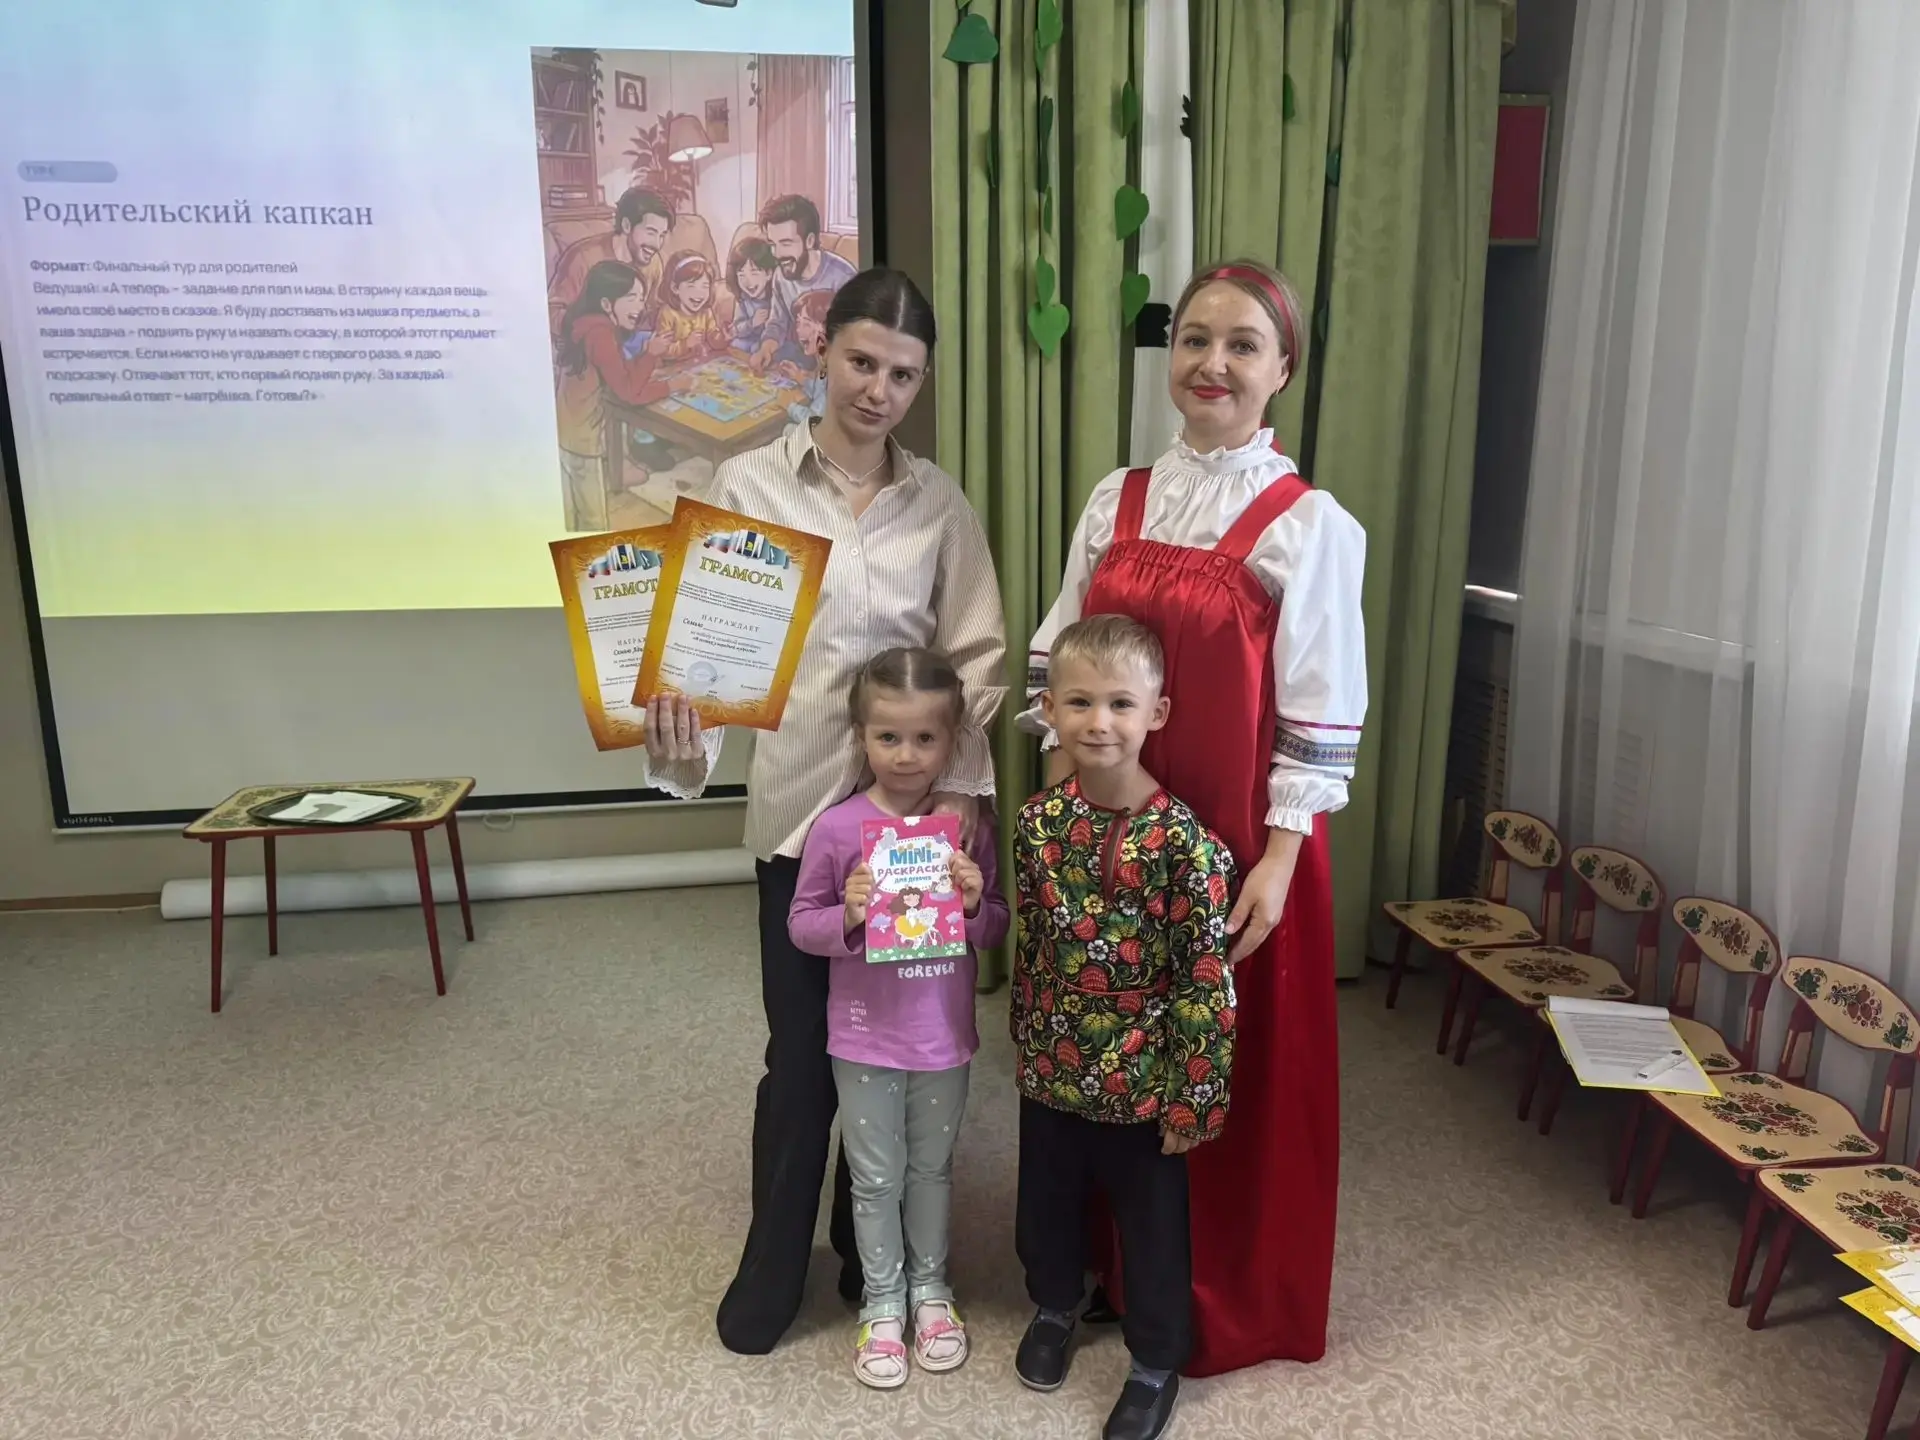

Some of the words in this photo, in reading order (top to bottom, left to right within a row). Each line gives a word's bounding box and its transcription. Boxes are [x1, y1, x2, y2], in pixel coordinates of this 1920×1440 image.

[22, 195, 251, 227] Родительский
[263, 204, 373, 225] капкан
[30, 260, 90, 275] Формат:
[93, 260, 170, 273] Финальный
[173, 263, 196, 276] тур
[199, 263, 223, 274] для
[225, 262, 298, 276] родителей
[33, 281, 99, 297] Ведущий:
[122, 283, 170, 298] теперь
[182, 283, 239, 296] задание
[241, 284, 265, 296] для
[268, 284, 291, 296] пап
[294, 285, 303, 295] и
[338, 284, 348, 296] В
[350, 285, 401, 299] старину
[405, 286, 451, 298] каждая
[454, 286, 488, 298] вещь
[37, 306, 80, 317] имела
[82, 303, 116, 317] своё
[118, 305, 160, 317] место
[162, 306, 170, 316] в
[172, 305, 221, 317] сказке.
[224, 304, 233, 317] Я
[235, 303, 266, 320] буду
[269, 306, 338, 318] доставать
[340, 307, 355, 318] из
[357, 307, 399, 318] мешка
[473, 308, 481, 318] а
[40, 327, 75, 338] ваша
[77, 327, 126, 340] задача
[138, 327, 194, 339] поднять
[195, 328, 227, 341] руку
[228, 328, 238, 338] и
[239, 328, 292, 339] назвать
[343, 328, 351, 339] в
[354, 327, 406, 342] которой
[409, 328, 438, 339] этот
[440, 328, 497, 341] предмет
[136, 347, 169, 360] Если
[170, 349, 209, 360] никто
[211, 350, 229, 360] не
[232, 349, 299, 363] угадывает
[302, 350, 311, 360] с
[313, 350, 367, 363] первого
[404, 350, 412, 360] я
[414, 350, 442, 361] даю
[46, 370, 119, 384] подсказку.
[121, 368, 186, 381] Отвечает
[216, 370, 240, 381] кто
[241, 369, 291, 383] первый
[293, 370, 342, 382] поднял
[343, 370, 376, 384] руку.
[377, 368, 394, 381] За
[396, 368, 445, 382] каждый
[49, 390, 132, 405] правильный
[133, 391, 172, 402] ответ
[700, 556, 784, 591] ГРАМОТА
[593, 578, 658, 601] ГРАМОТ
[701, 614, 761, 633] НАГРАЖДАЕТ
[877, 864, 949, 877] РАСКРАСКА
[898, 962, 955, 979] FOREVER
